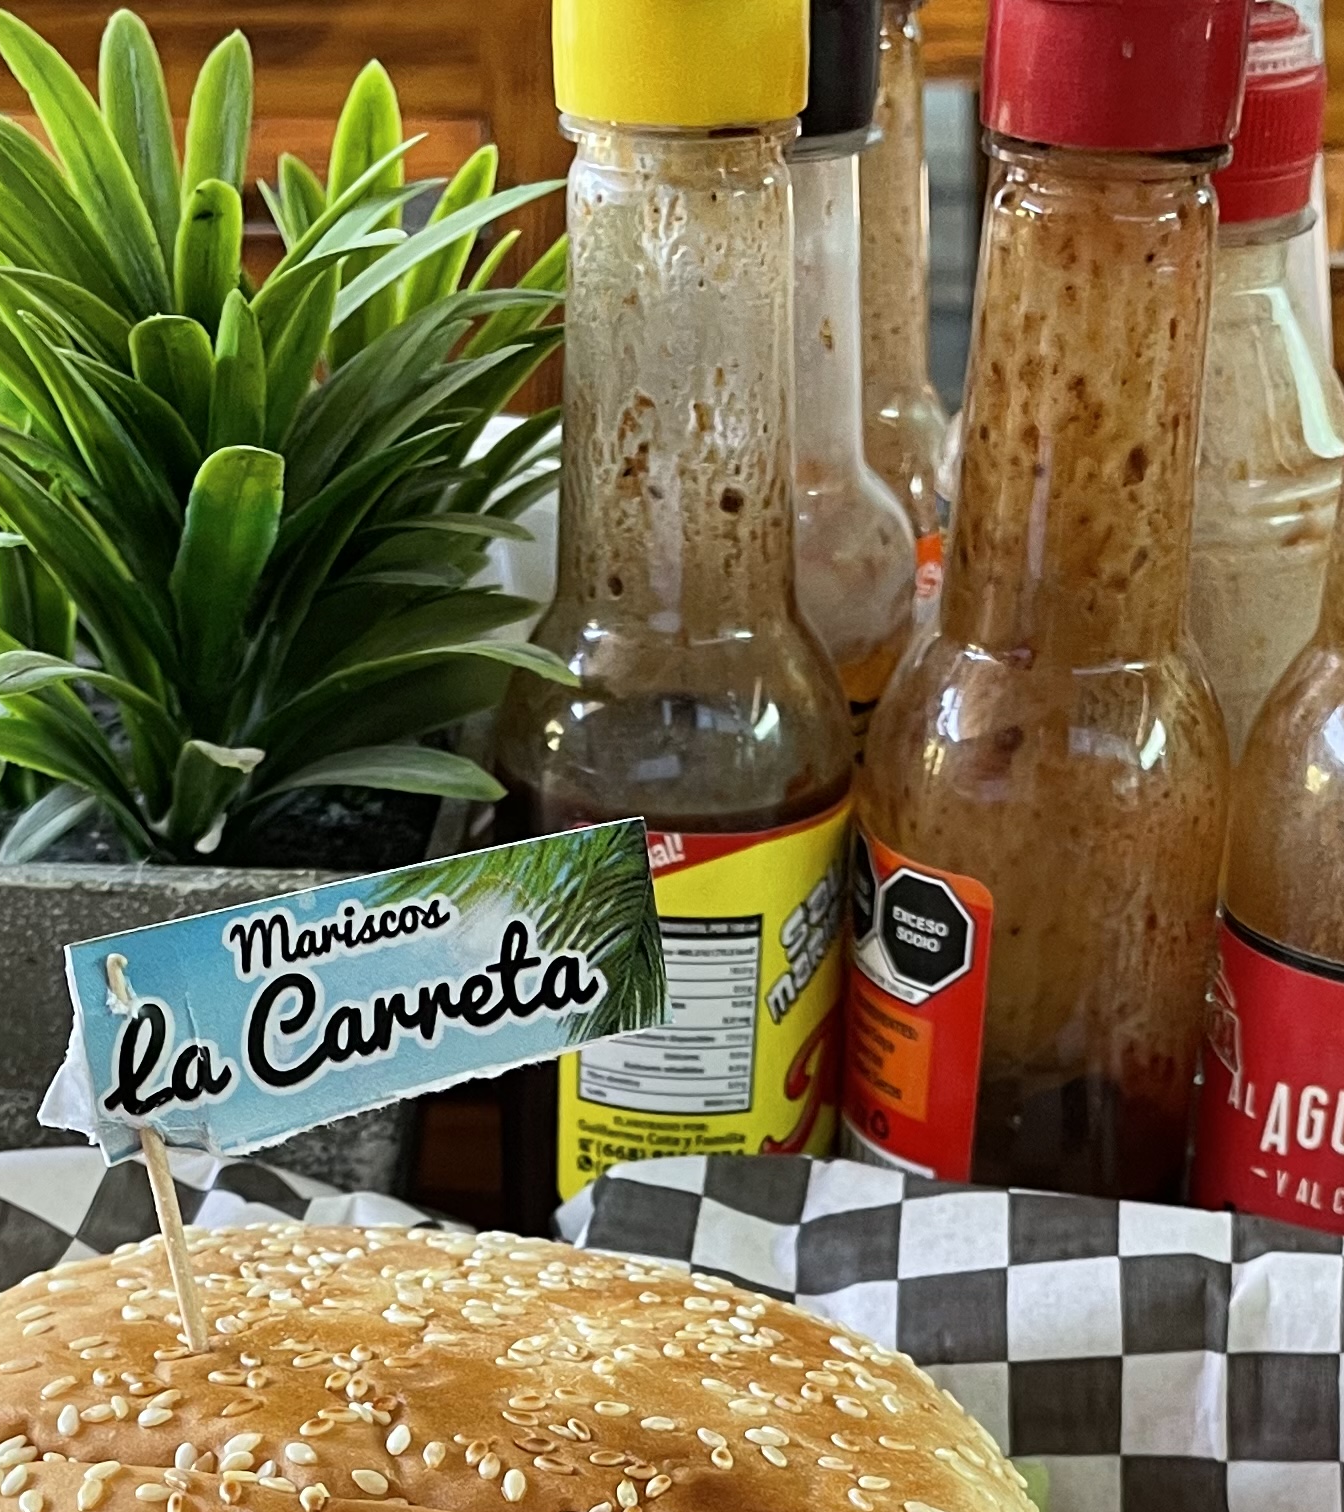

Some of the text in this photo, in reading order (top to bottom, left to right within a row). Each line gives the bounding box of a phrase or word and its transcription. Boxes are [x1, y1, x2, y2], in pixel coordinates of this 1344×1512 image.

[229, 899, 451, 974] Mariscos
[892, 905, 950, 937] EXCESO
[895, 926, 942, 953] SODIO
[246, 920, 599, 1088] Carreta
[1275, 1169, 1289, 1198] Y
[1295, 1178, 1322, 1210] AL
